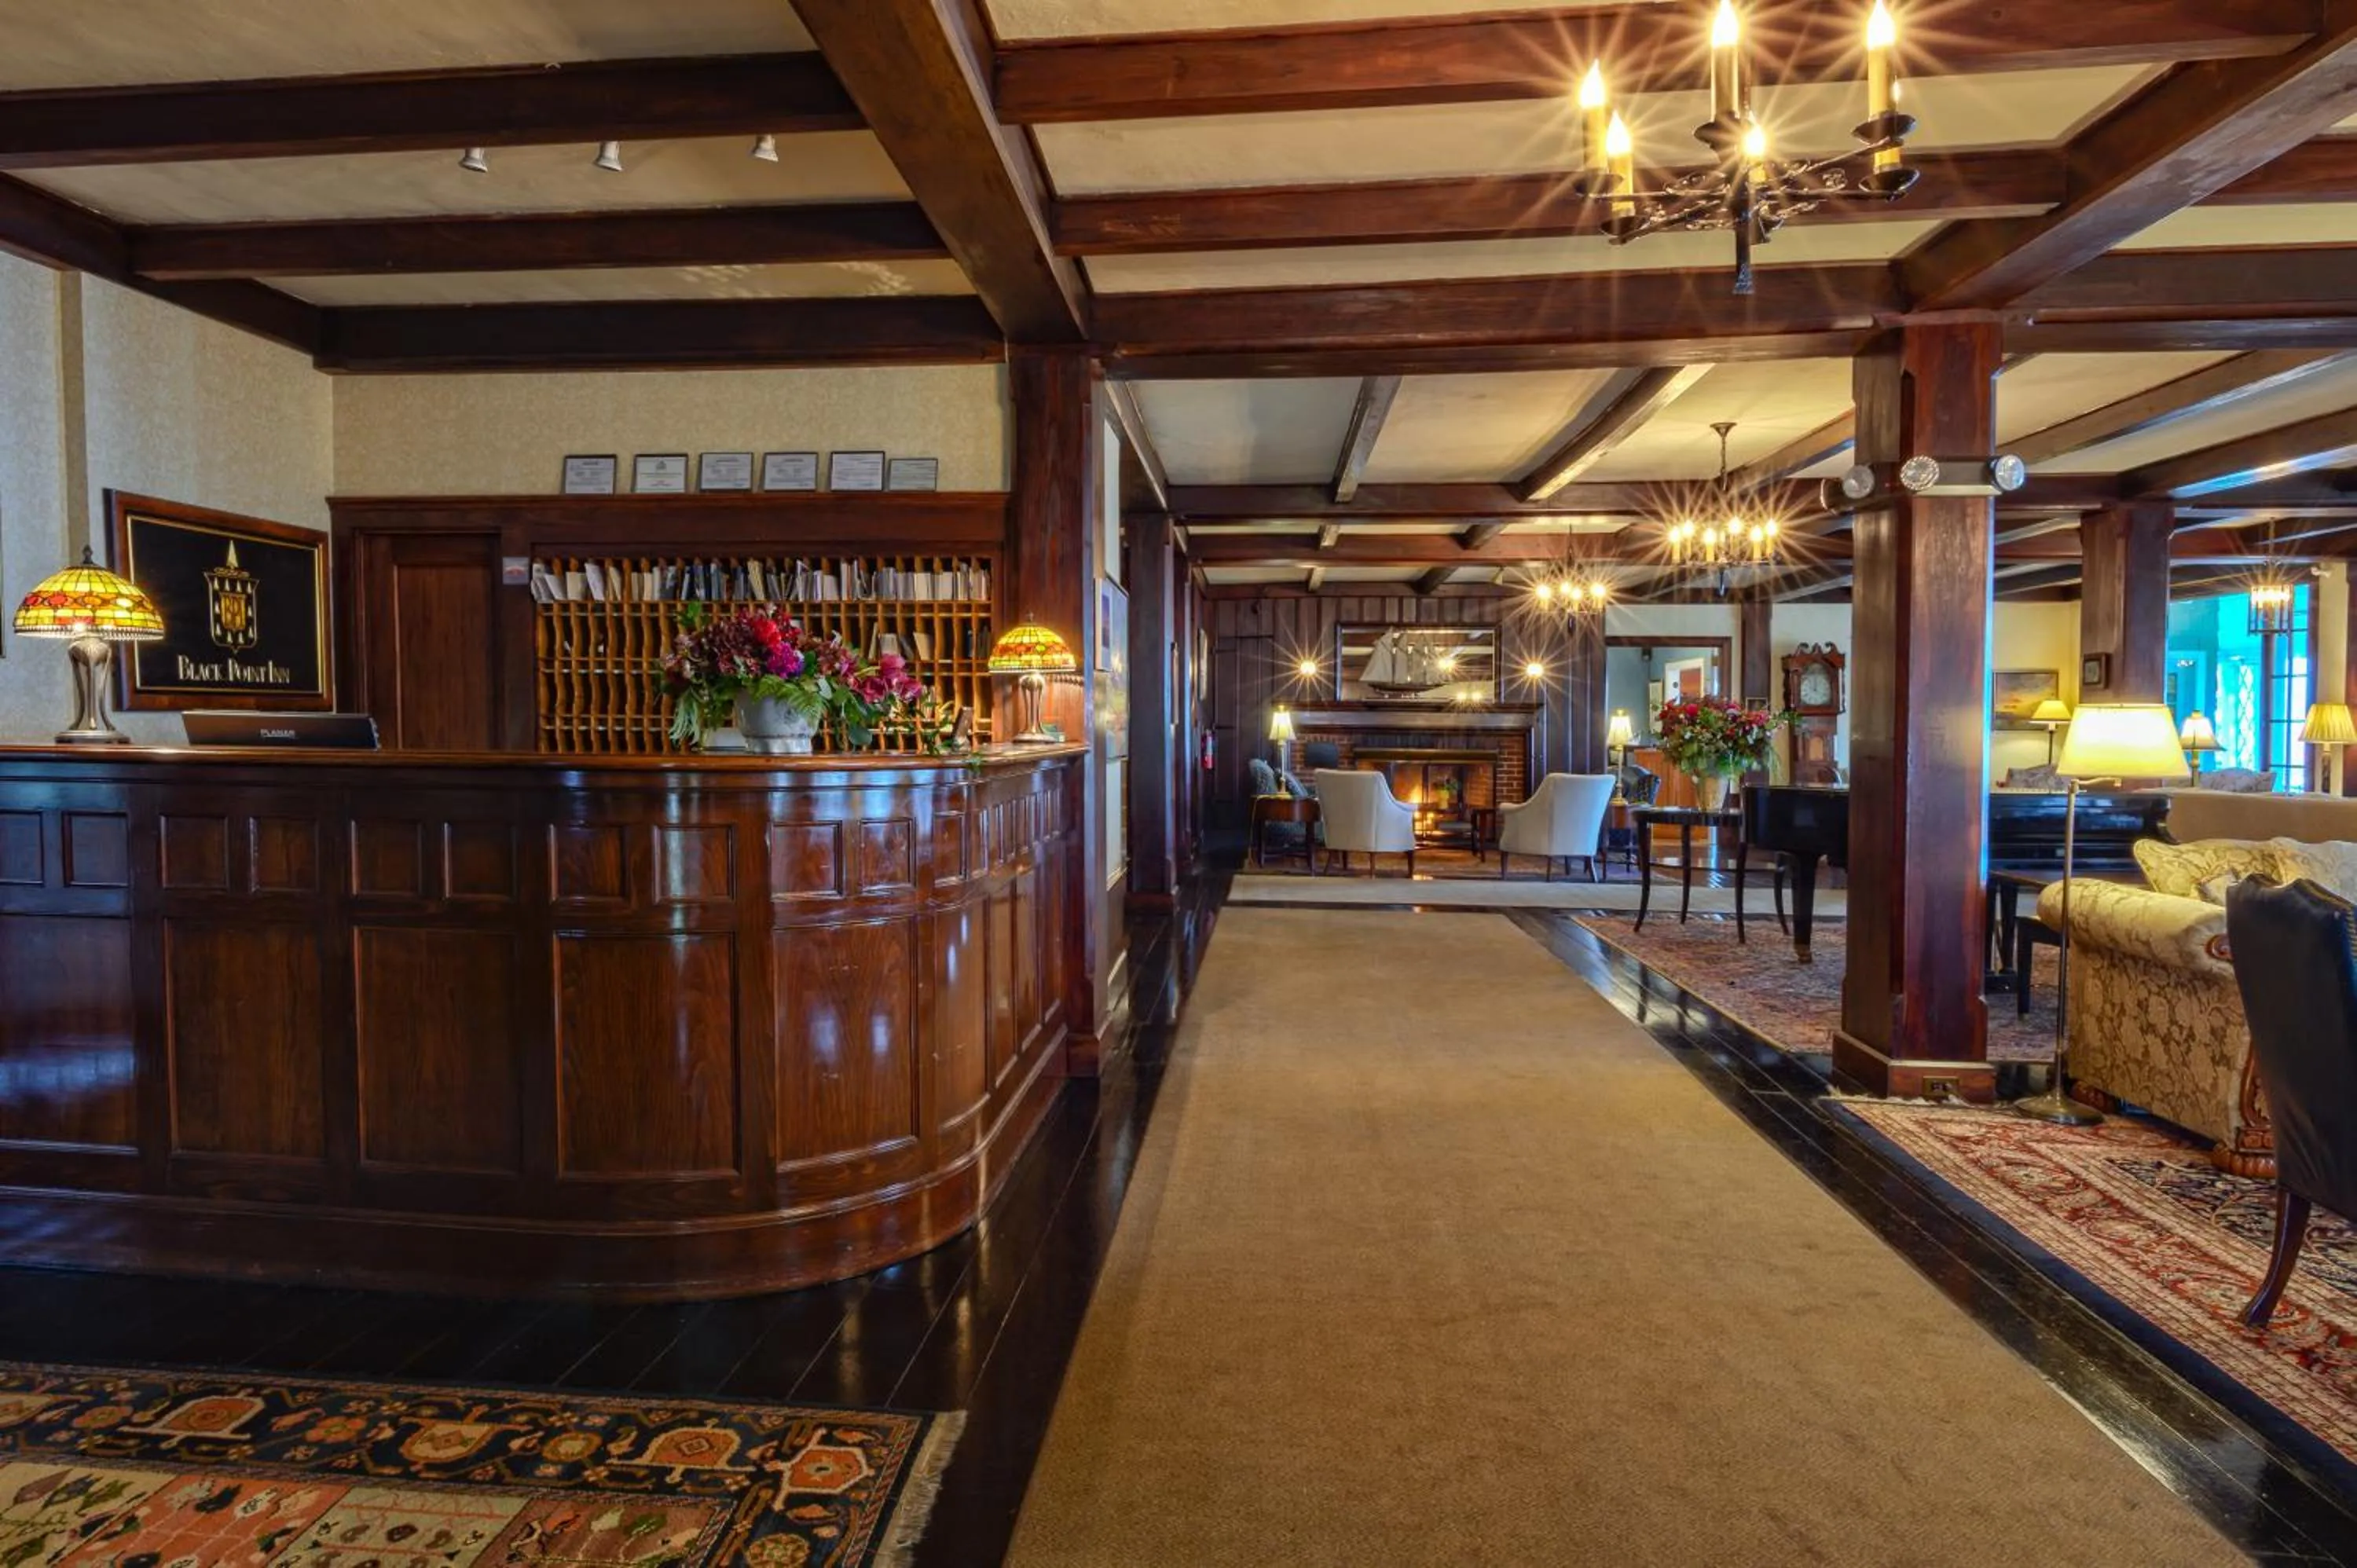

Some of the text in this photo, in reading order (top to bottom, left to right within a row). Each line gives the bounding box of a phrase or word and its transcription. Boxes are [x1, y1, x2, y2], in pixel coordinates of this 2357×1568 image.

[178, 654, 290, 683] BLACK POINT INN
